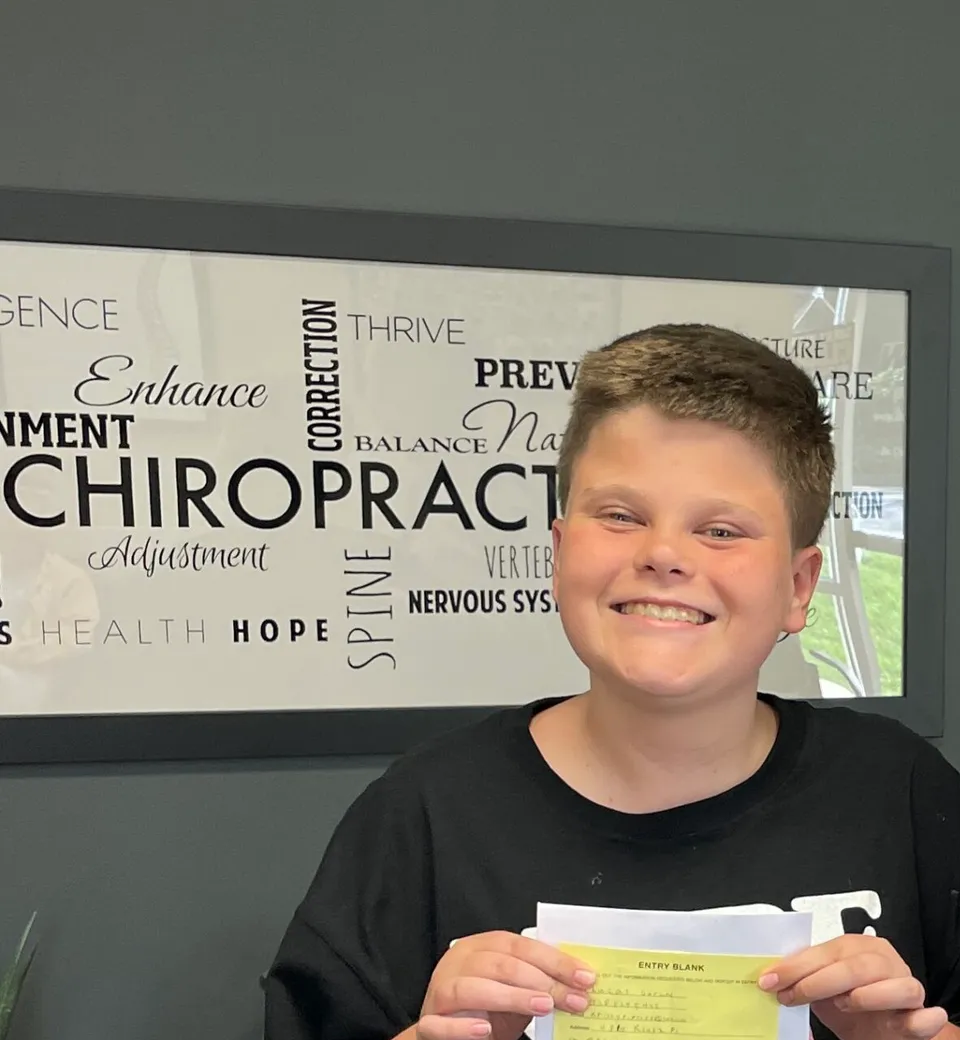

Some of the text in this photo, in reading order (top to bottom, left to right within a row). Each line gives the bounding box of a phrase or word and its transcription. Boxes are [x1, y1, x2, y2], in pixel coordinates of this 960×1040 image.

[347, 313, 466, 345] THRIVE
[74, 354, 268, 408] Enhance
[302, 298, 342, 452] CORRECTION
[354, 435, 488, 454] BALANCE
[462, 398, 566, 453] Na
[3, 453, 559, 531] CHIROPRACT
[88, 534, 270, 577] Adjustment
[344, 545, 396, 670] SPINE
[409, 588, 507, 614] NERVOUS
[42, 618, 205, 645] HEALTH
[233, 618, 329, 643] HOPE
[638, 961, 705, 972] ENTRY BLANK
